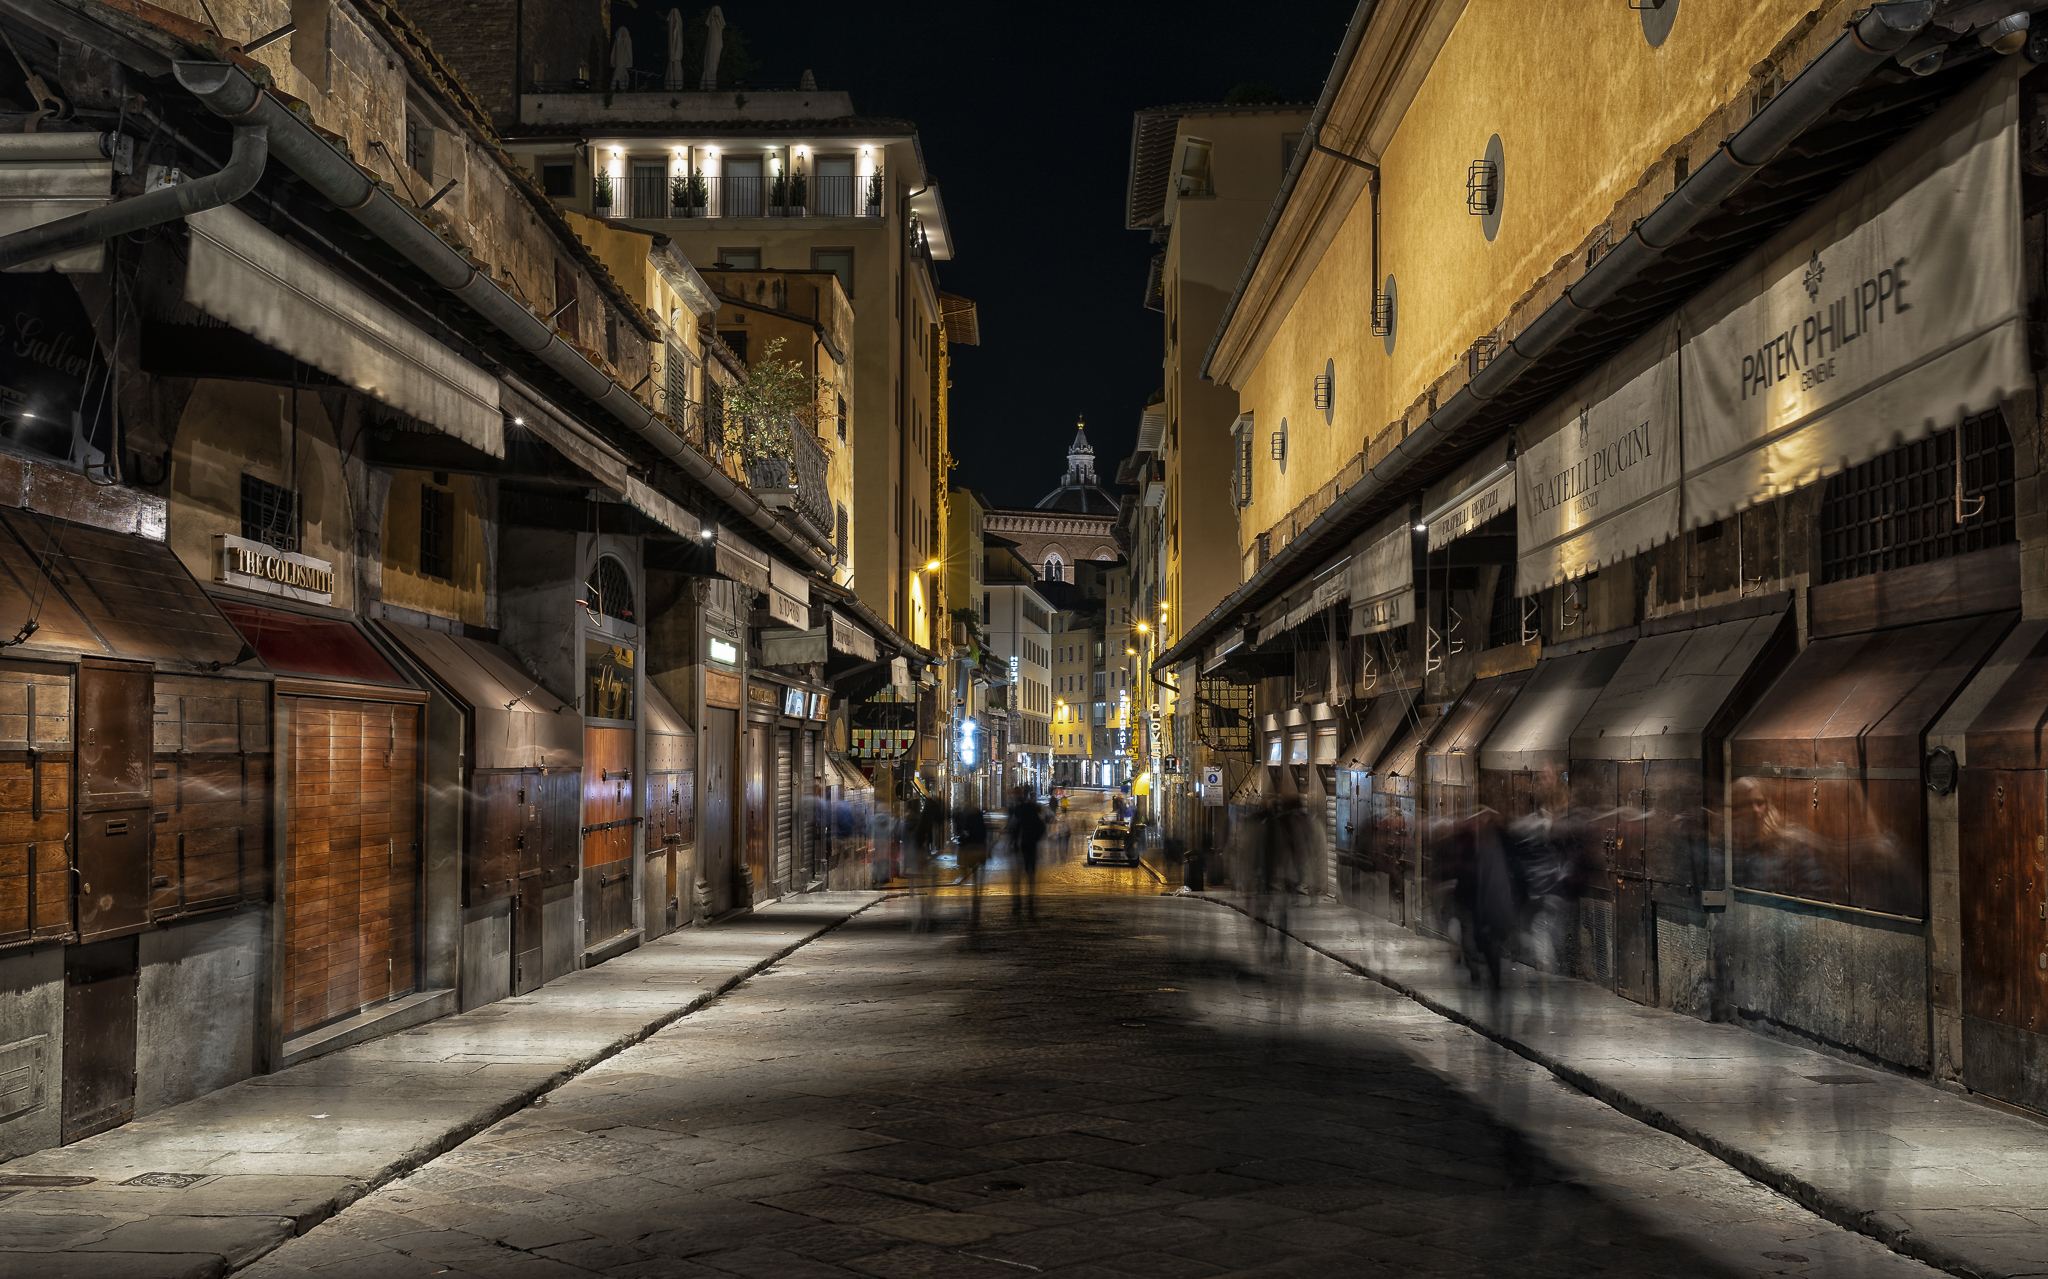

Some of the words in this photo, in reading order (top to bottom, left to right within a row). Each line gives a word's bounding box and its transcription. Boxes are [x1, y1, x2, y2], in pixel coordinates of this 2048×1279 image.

[13, 311, 100, 397] Gallery
[1741, 324, 1800, 401] PATEK
[1803, 256, 1913, 366] PHILIPPE
[1532, 457, 1590, 517] FRATELLI
[1593, 419, 1652, 487] PICCINI
[1442, 506, 1469, 535] FRATELLI
[1471, 487, 1499, 518] PERUZZI
[236, 547, 264, 577] THE
[266, 555, 336, 594] GOLDSMITH
[1150, 703, 1162, 760] GLOVES
